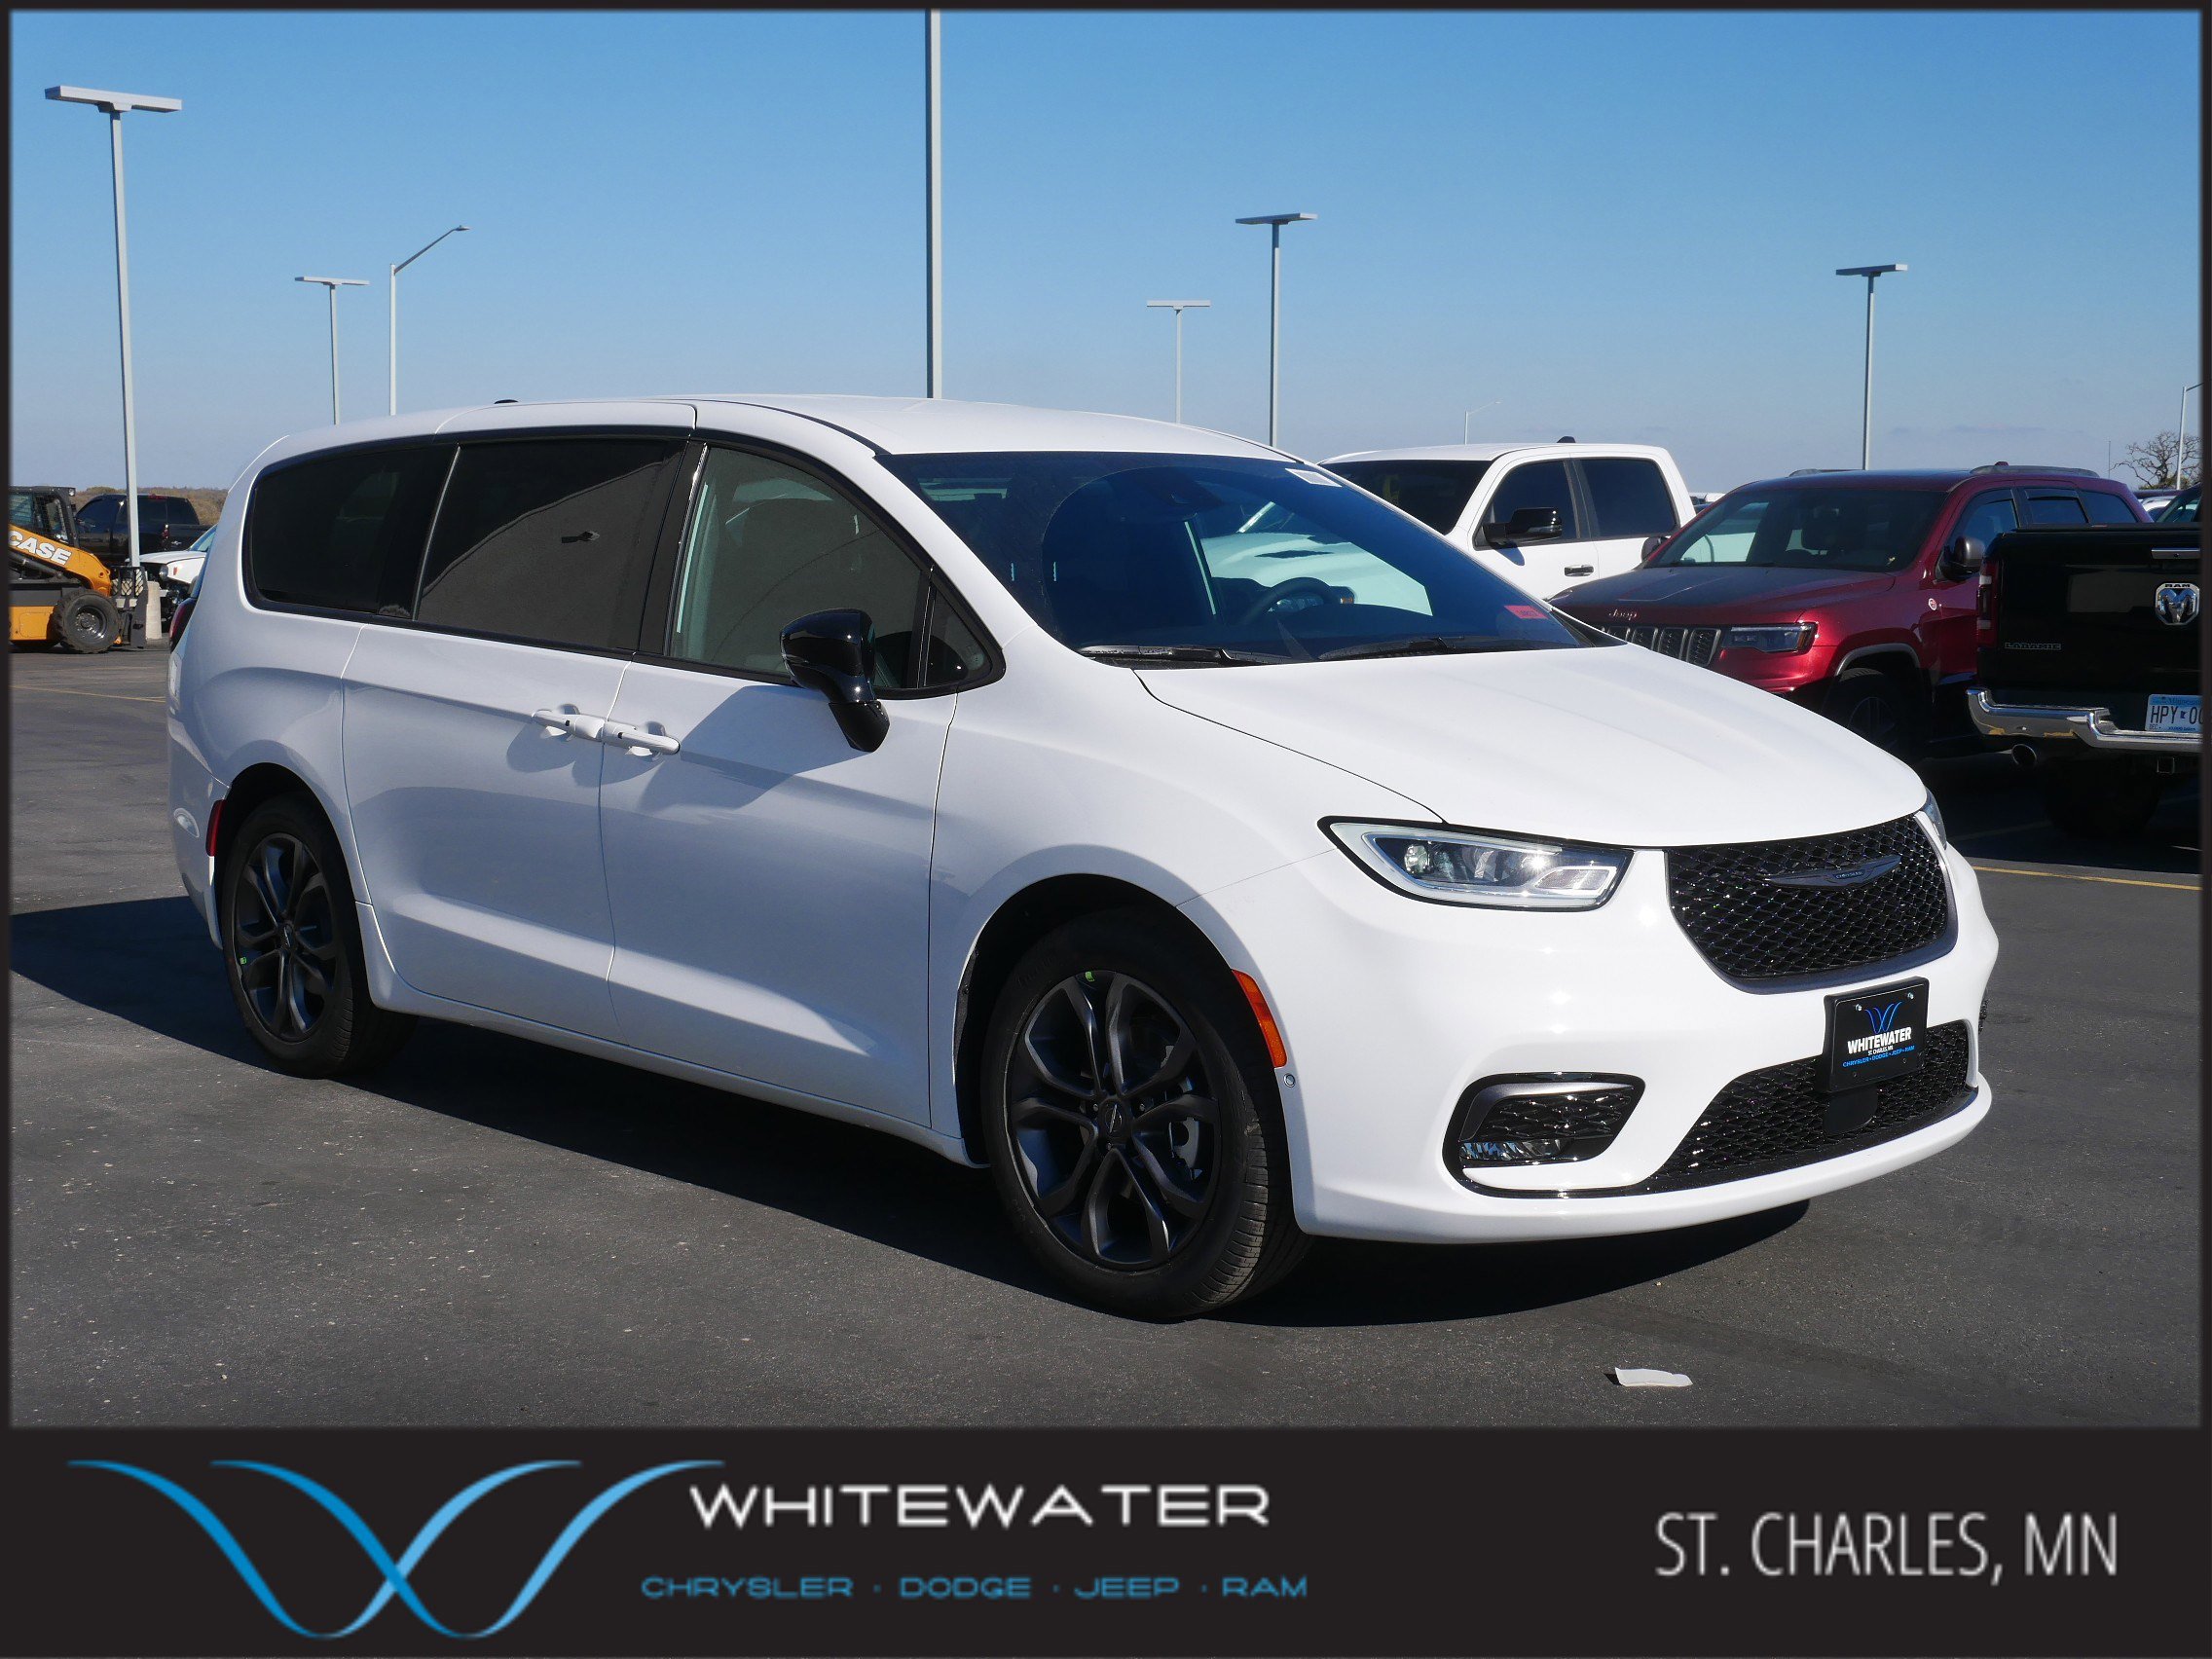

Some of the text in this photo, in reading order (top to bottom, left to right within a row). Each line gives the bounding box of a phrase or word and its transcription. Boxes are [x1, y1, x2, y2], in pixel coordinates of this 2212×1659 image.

[8, 531, 72, 565] CASE
[2150, 705, 2178, 724] HPY
[1847, 1027, 1912, 1054] WHITEWATER
[1842, 1056, 1869, 1068] CHRYSLER
[1871, 1051, 1889, 1061] DODGE
[1890, 1048, 1903, 1056] JEEP
